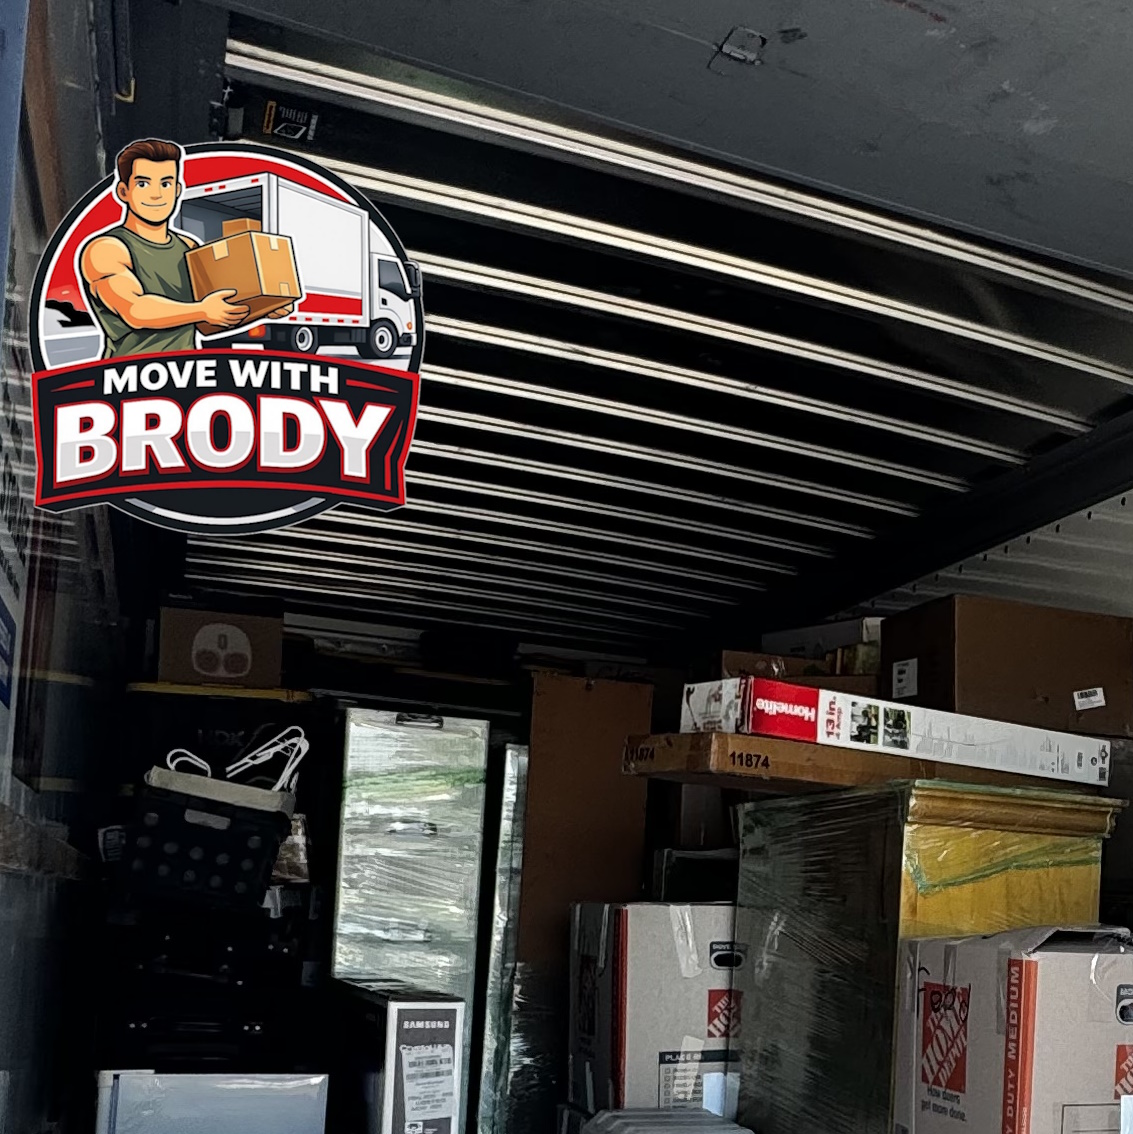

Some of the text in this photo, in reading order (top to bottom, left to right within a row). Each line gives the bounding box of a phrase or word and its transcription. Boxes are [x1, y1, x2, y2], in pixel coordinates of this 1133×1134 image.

[757, 698, 816, 722] Homelite
[729, 750, 771, 770] 11874
[1008, 965, 1020, 1060] MEDIUM
[1006, 1071, 1016, 1118] DUTY
